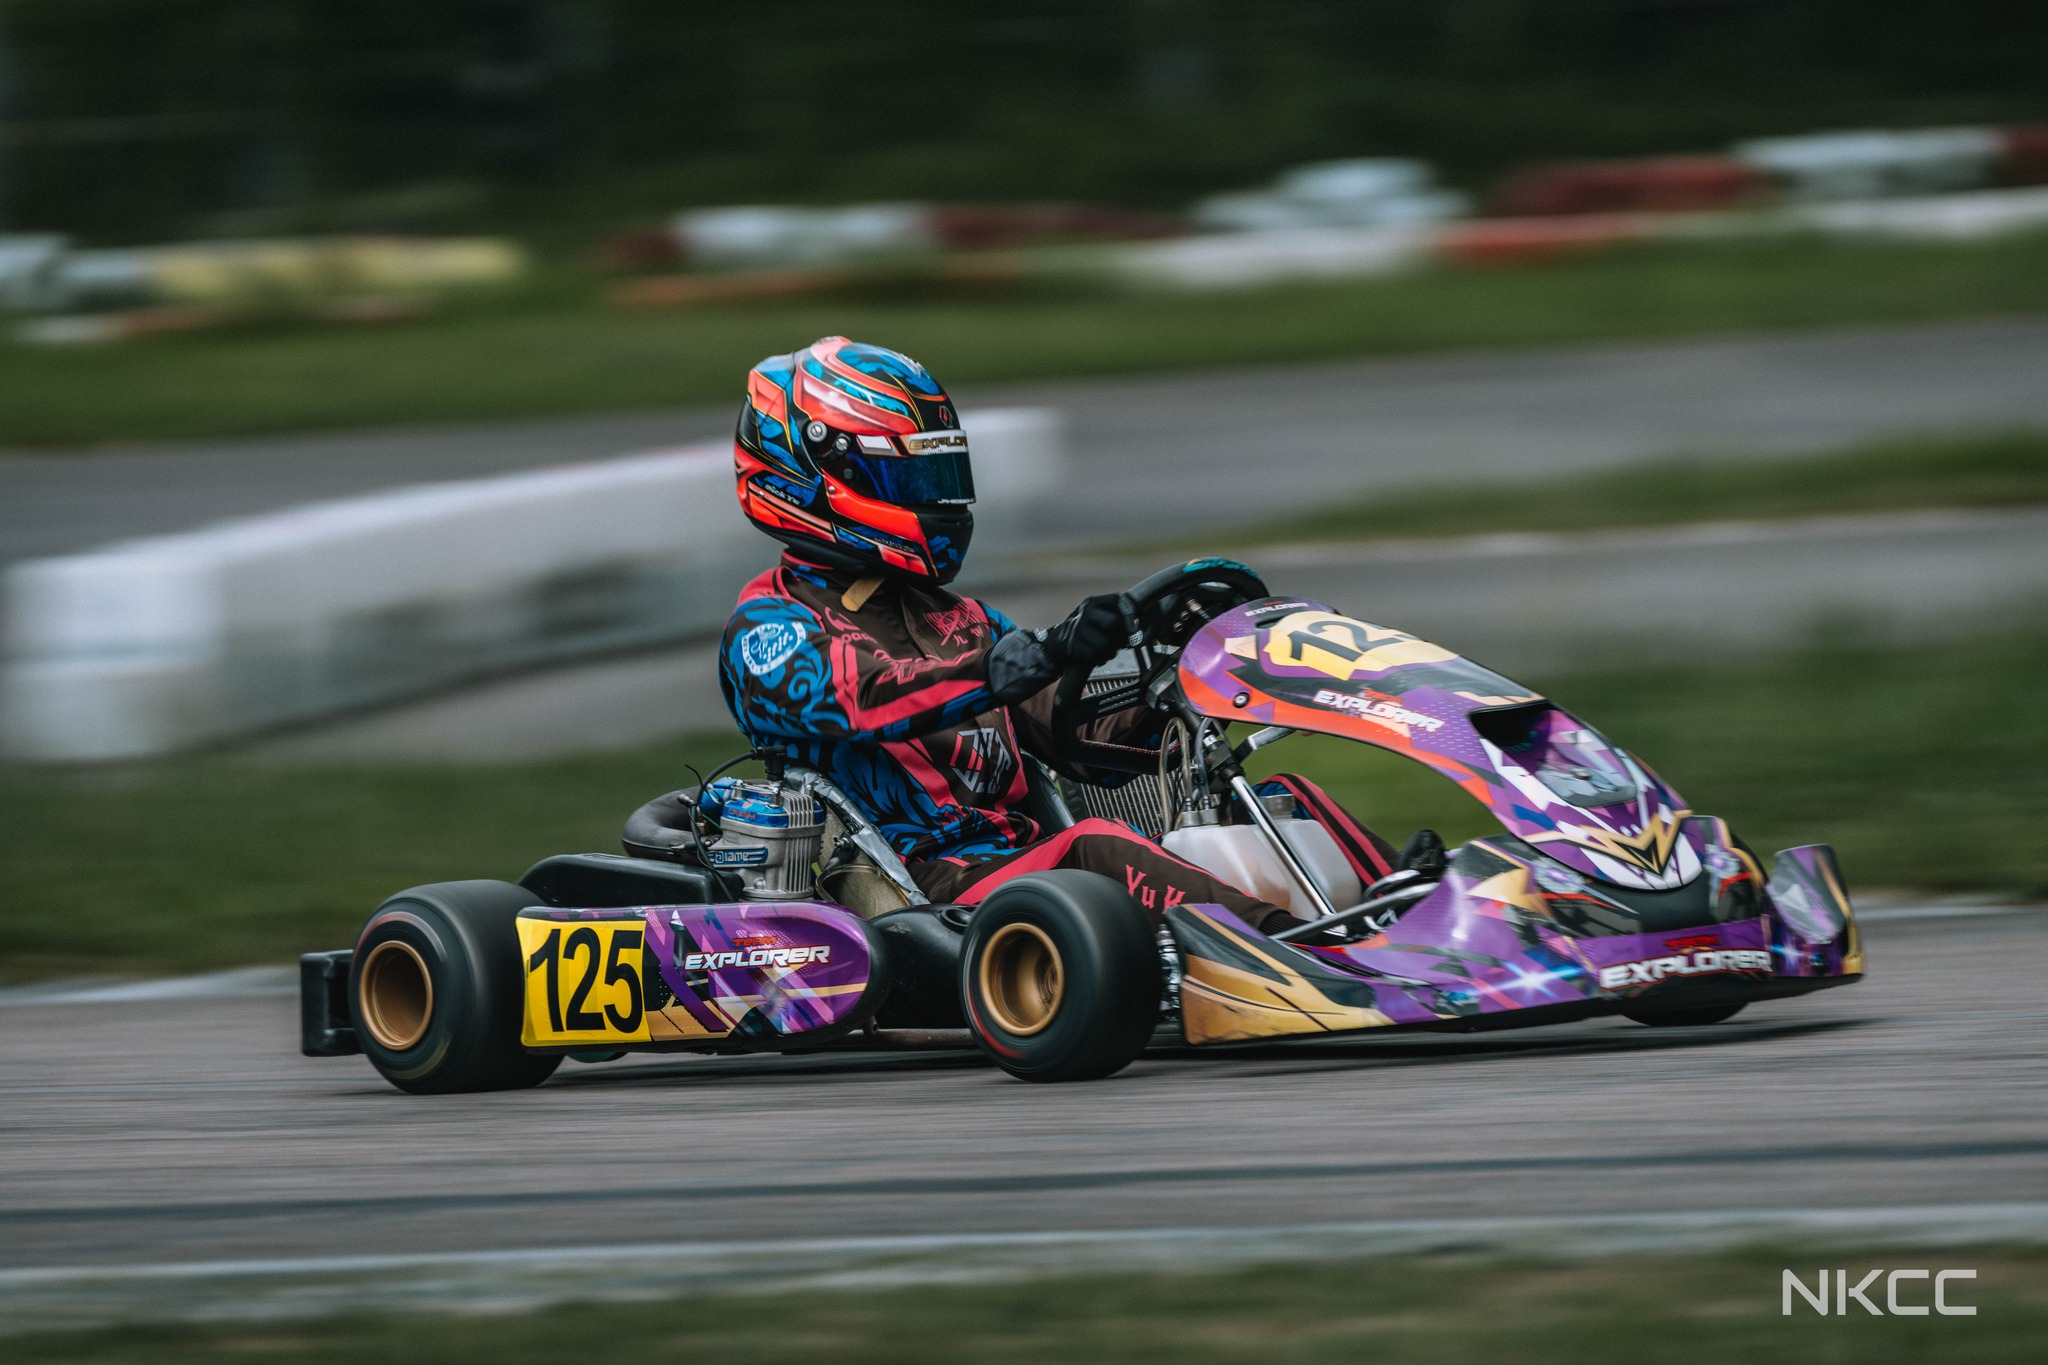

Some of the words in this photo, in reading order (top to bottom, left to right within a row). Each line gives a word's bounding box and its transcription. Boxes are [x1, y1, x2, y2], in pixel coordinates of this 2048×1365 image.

[1313, 688, 1446, 733] EXPLORER
[684, 944, 831, 971] EXPLORER
[732, 936, 777, 947] TEAM
[530, 927, 643, 1034] 125
[1599, 948, 1774, 991] EXPLORER
